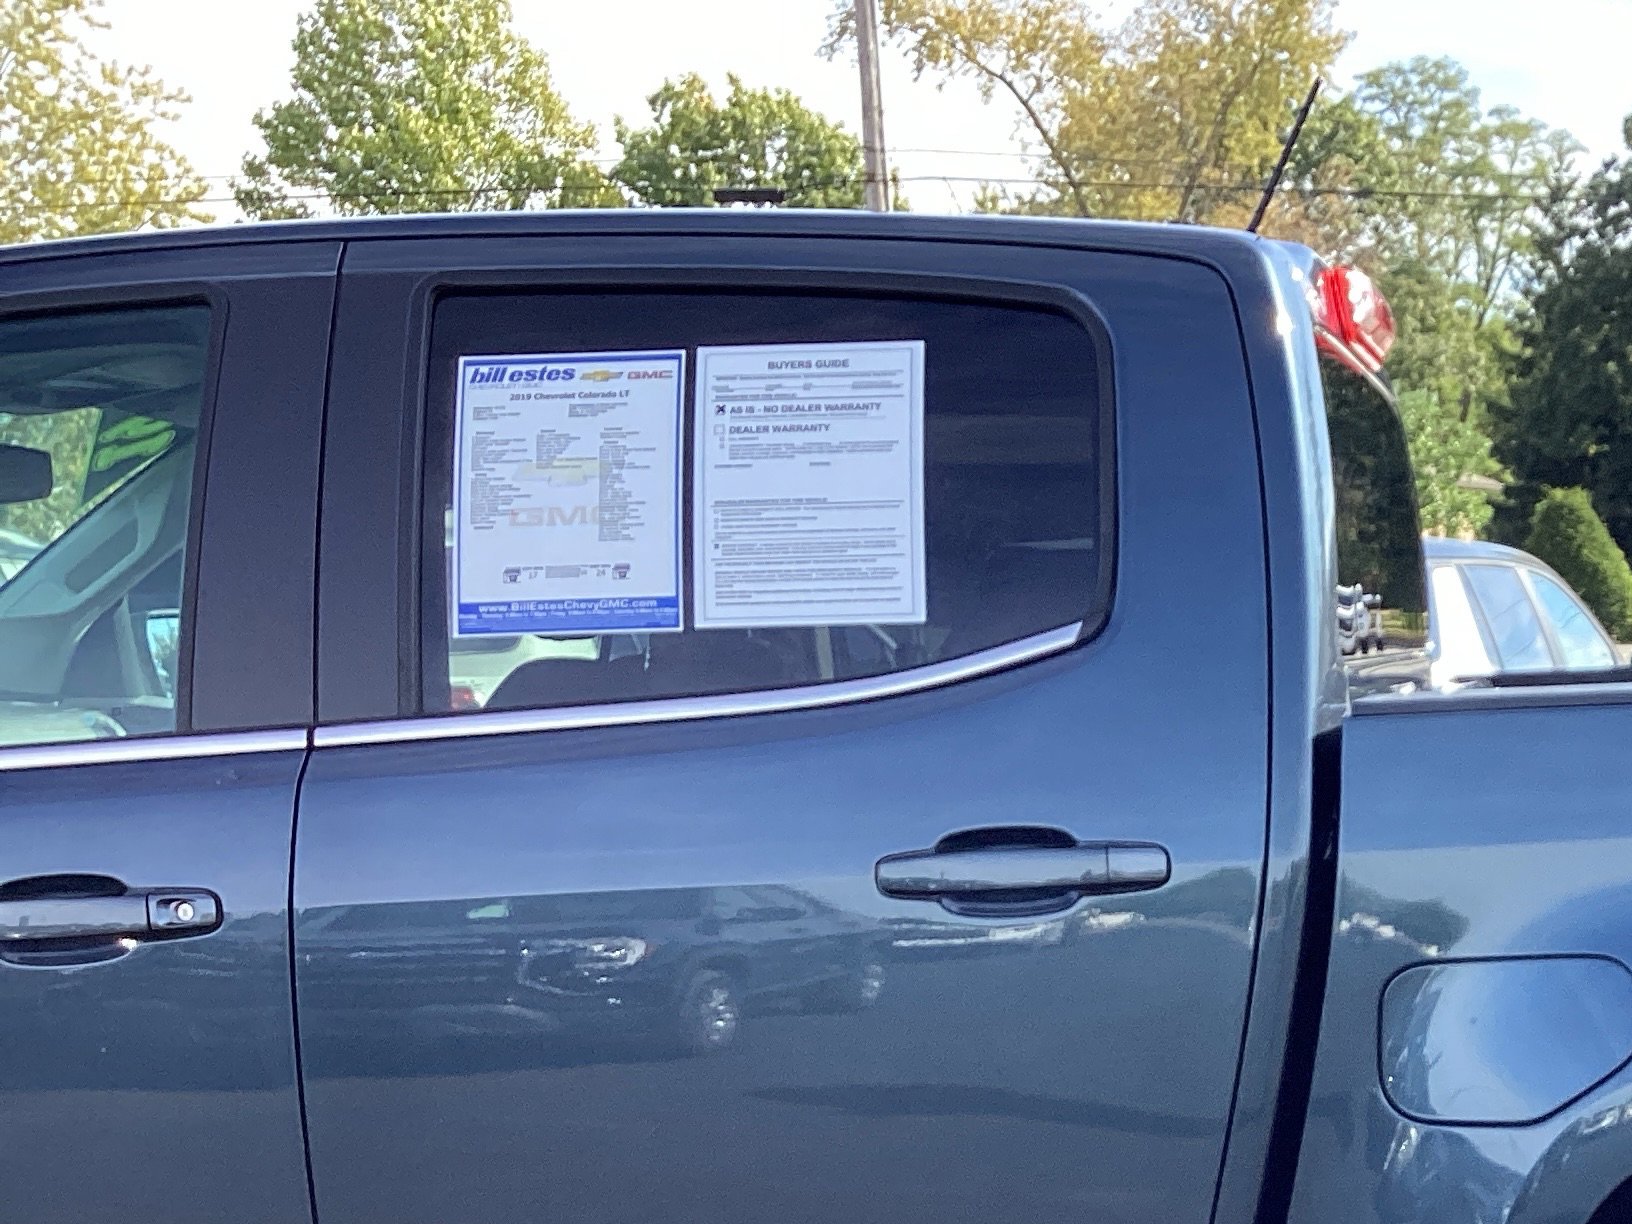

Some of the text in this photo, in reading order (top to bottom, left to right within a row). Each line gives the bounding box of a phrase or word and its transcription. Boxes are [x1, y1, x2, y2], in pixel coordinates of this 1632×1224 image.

[768, 359, 850, 370] BUYERS GUIDE
[470, 365, 576, 384] bill estes
[627, 369, 674, 380] GMC
[533, 391, 576, 400] Chevrolet
[578, 390, 617, 399] Colorado
[619, 389, 630, 398] LT
[730, 406, 743, 414] AS
[745, 405, 755, 414] IS
[763, 404, 779, 413] NO
[781, 403, 822, 413] DEALER
[824, 402, 882, 412] WARRANTY
[729, 423, 831, 434] DEALER WARRANTY
[479, 599, 657, 613] www.BillEstesChevyGMC.com
